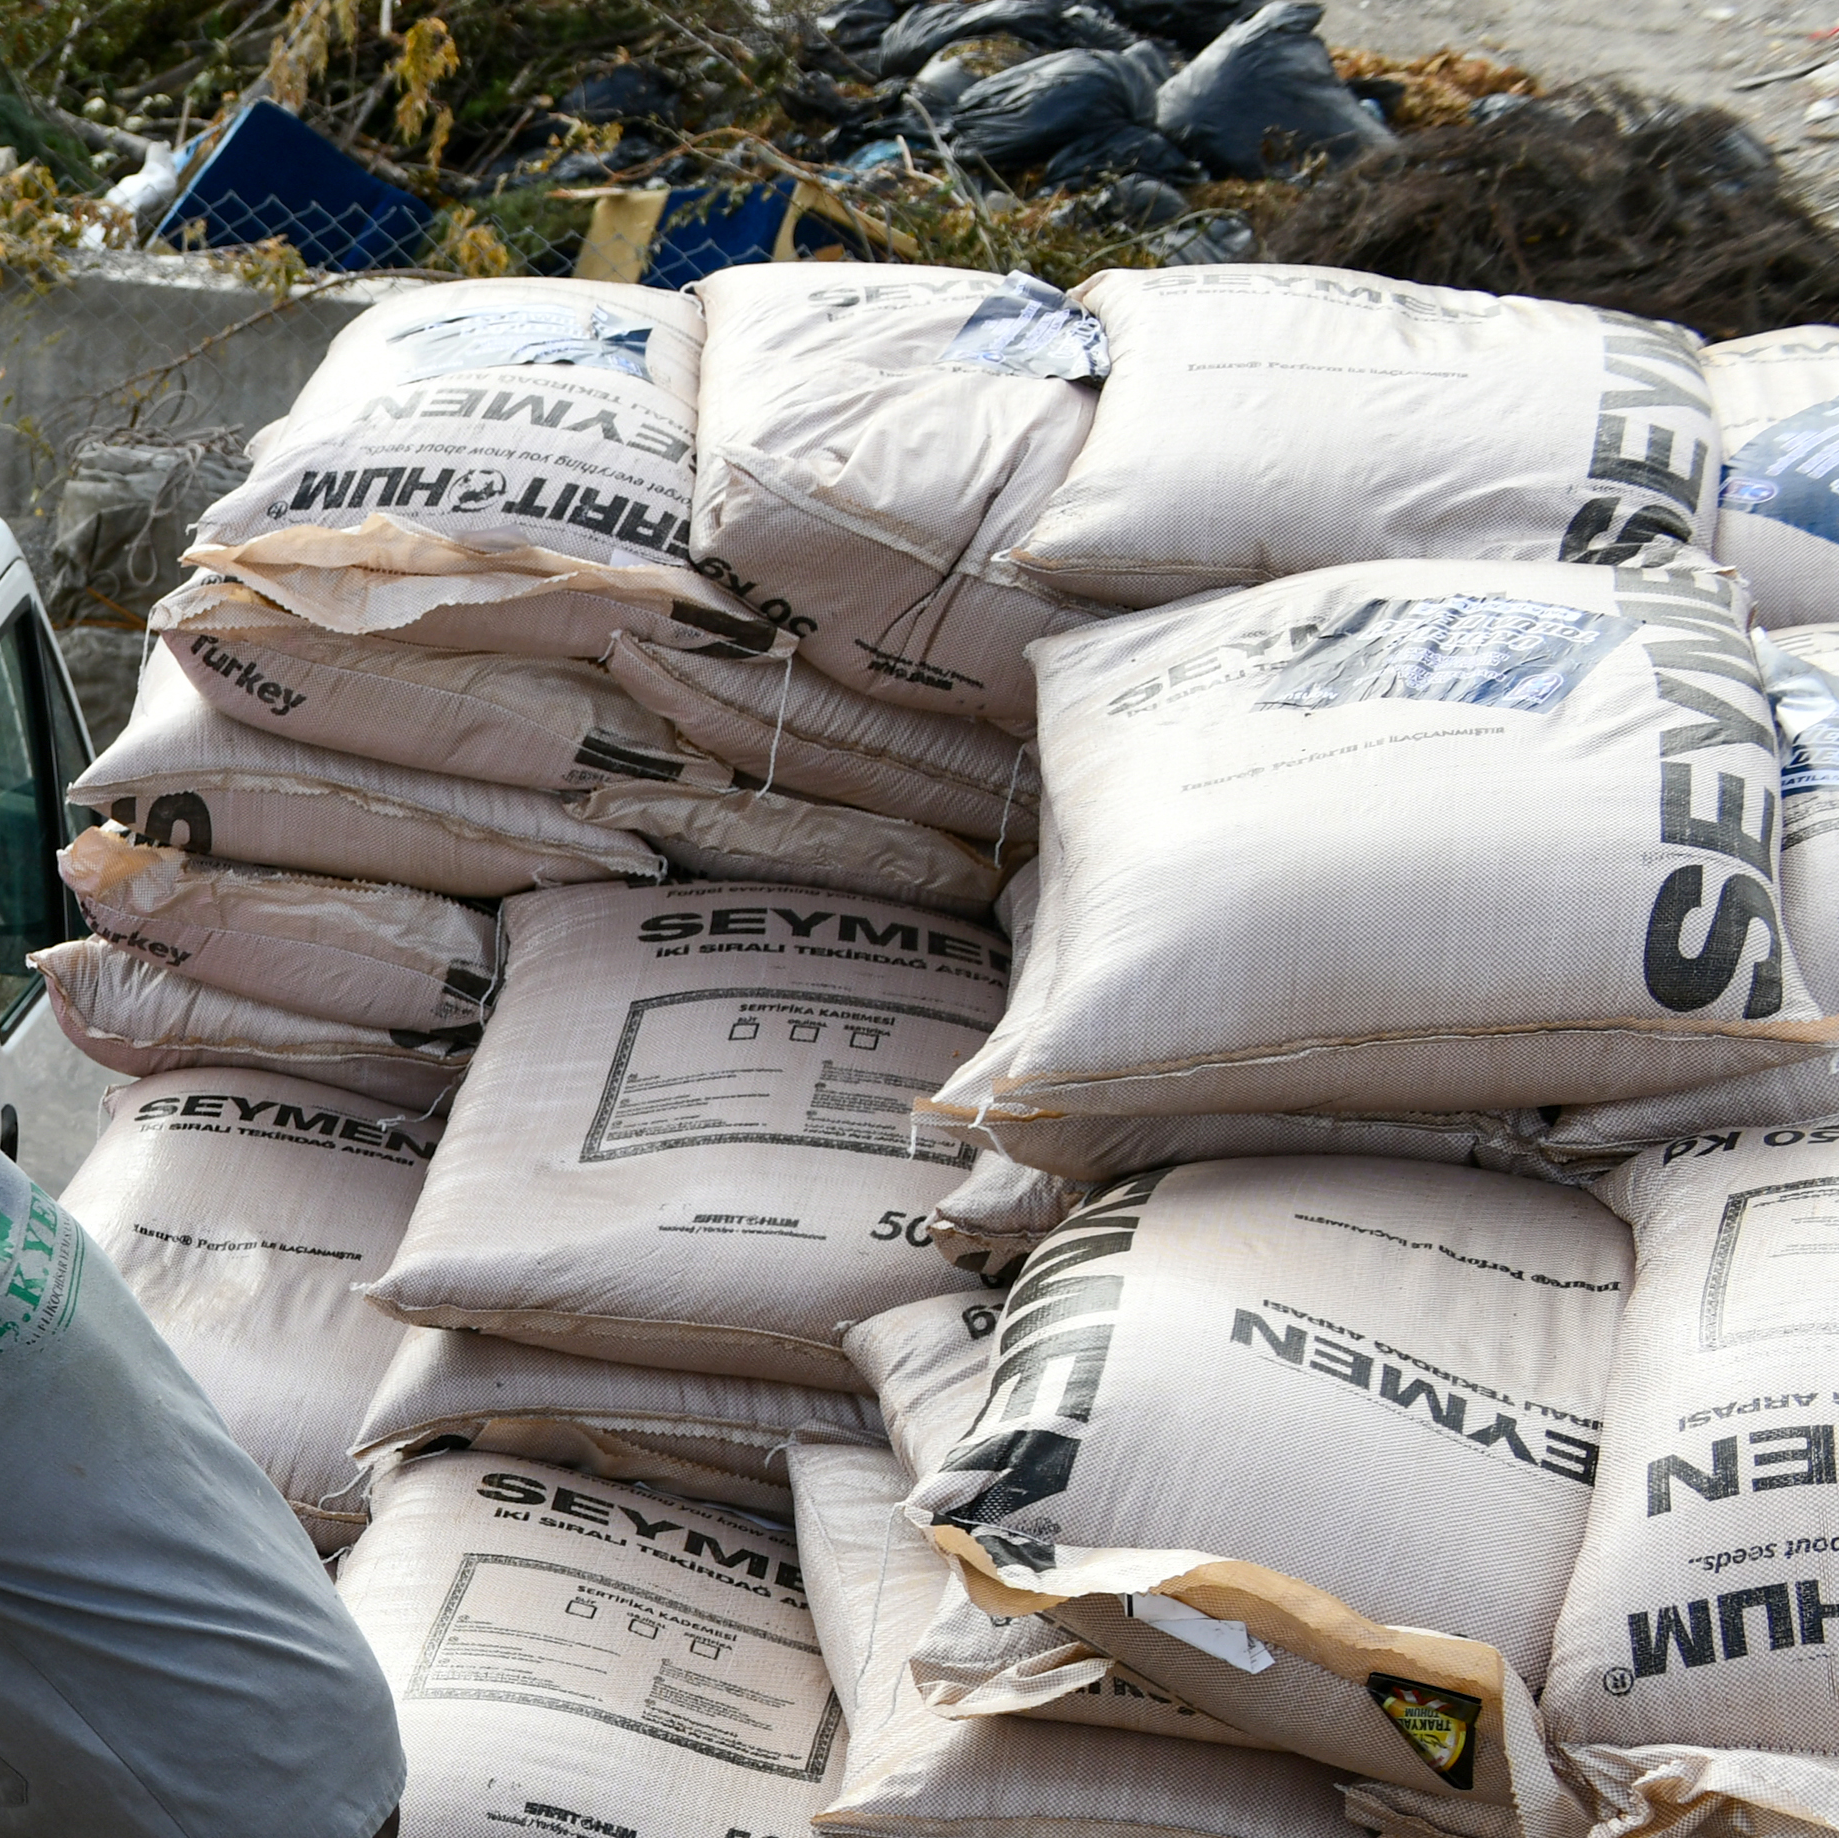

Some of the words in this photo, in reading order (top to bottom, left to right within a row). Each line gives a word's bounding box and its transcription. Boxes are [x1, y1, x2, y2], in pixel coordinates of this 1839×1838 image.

[1142, 271, 1503, 320] SEYMEN
[355, 386, 698, 475] EYMEN
[760, 596, 819, 640] 50
[189, 633, 309, 718] Turkey
[655, 942, 691, 959] İKİ
[698, 942, 786, 955] SIRALI
[792, 942, 929, 971] TEKİRDAĞ
[818, 1007, 897, 1026] KADEMESİ
[134, 1093, 439, 1162] SEYMEN
[168, 1122, 233, 1134] SIRALI
[237, 1126, 337, 1150] TEKİRDAĞ
[341, 1144, 415, 1167] ARPASI
[1263, 1298, 1365, 1342] ARPASI
[1374, 1338, 1517, 1407] TEKİRDAĞ
[1229, 1307, 1601, 1487] EYMEN
[1677, 1390, 1821, 1433] ARPASI
[493, 1507, 531, 1525] İKİ
[538, 1515, 628, 1548] SIRALI
[636, 1542, 773, 1599] TEKİRDAĞ
[716, 1514, 766, 1539] know
[577, 1584, 654, 1617] SERTİFİKA
[658, 1611, 739, 1643] KADEMESİ
